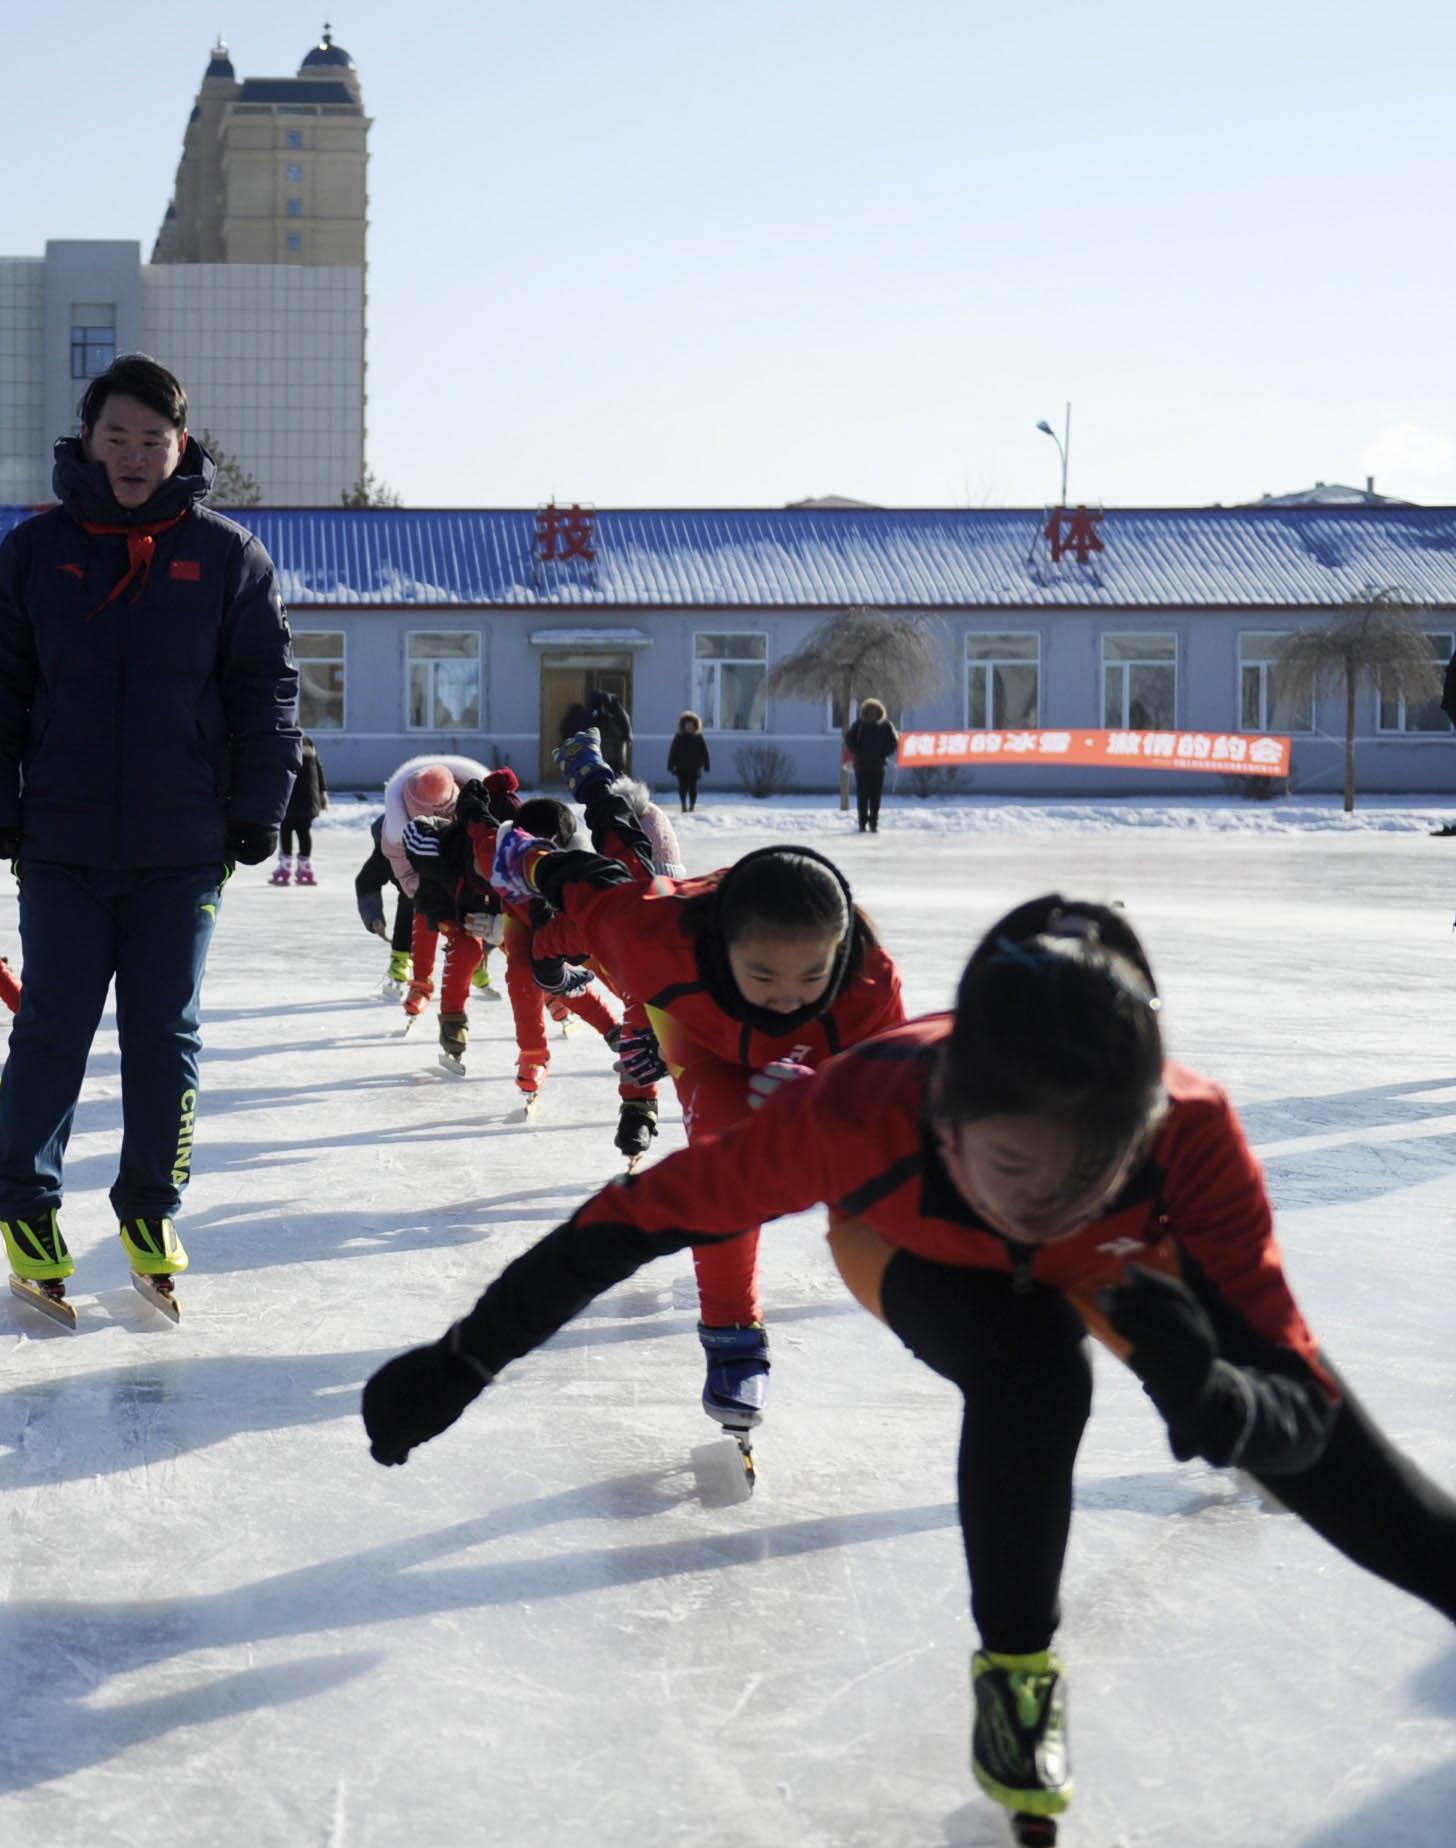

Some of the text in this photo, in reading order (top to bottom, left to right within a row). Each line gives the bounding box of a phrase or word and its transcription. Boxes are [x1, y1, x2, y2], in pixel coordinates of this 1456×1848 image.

[536, 504, 1104, 563] 技 体
[171, 1088, 197, 1187] CHINA
